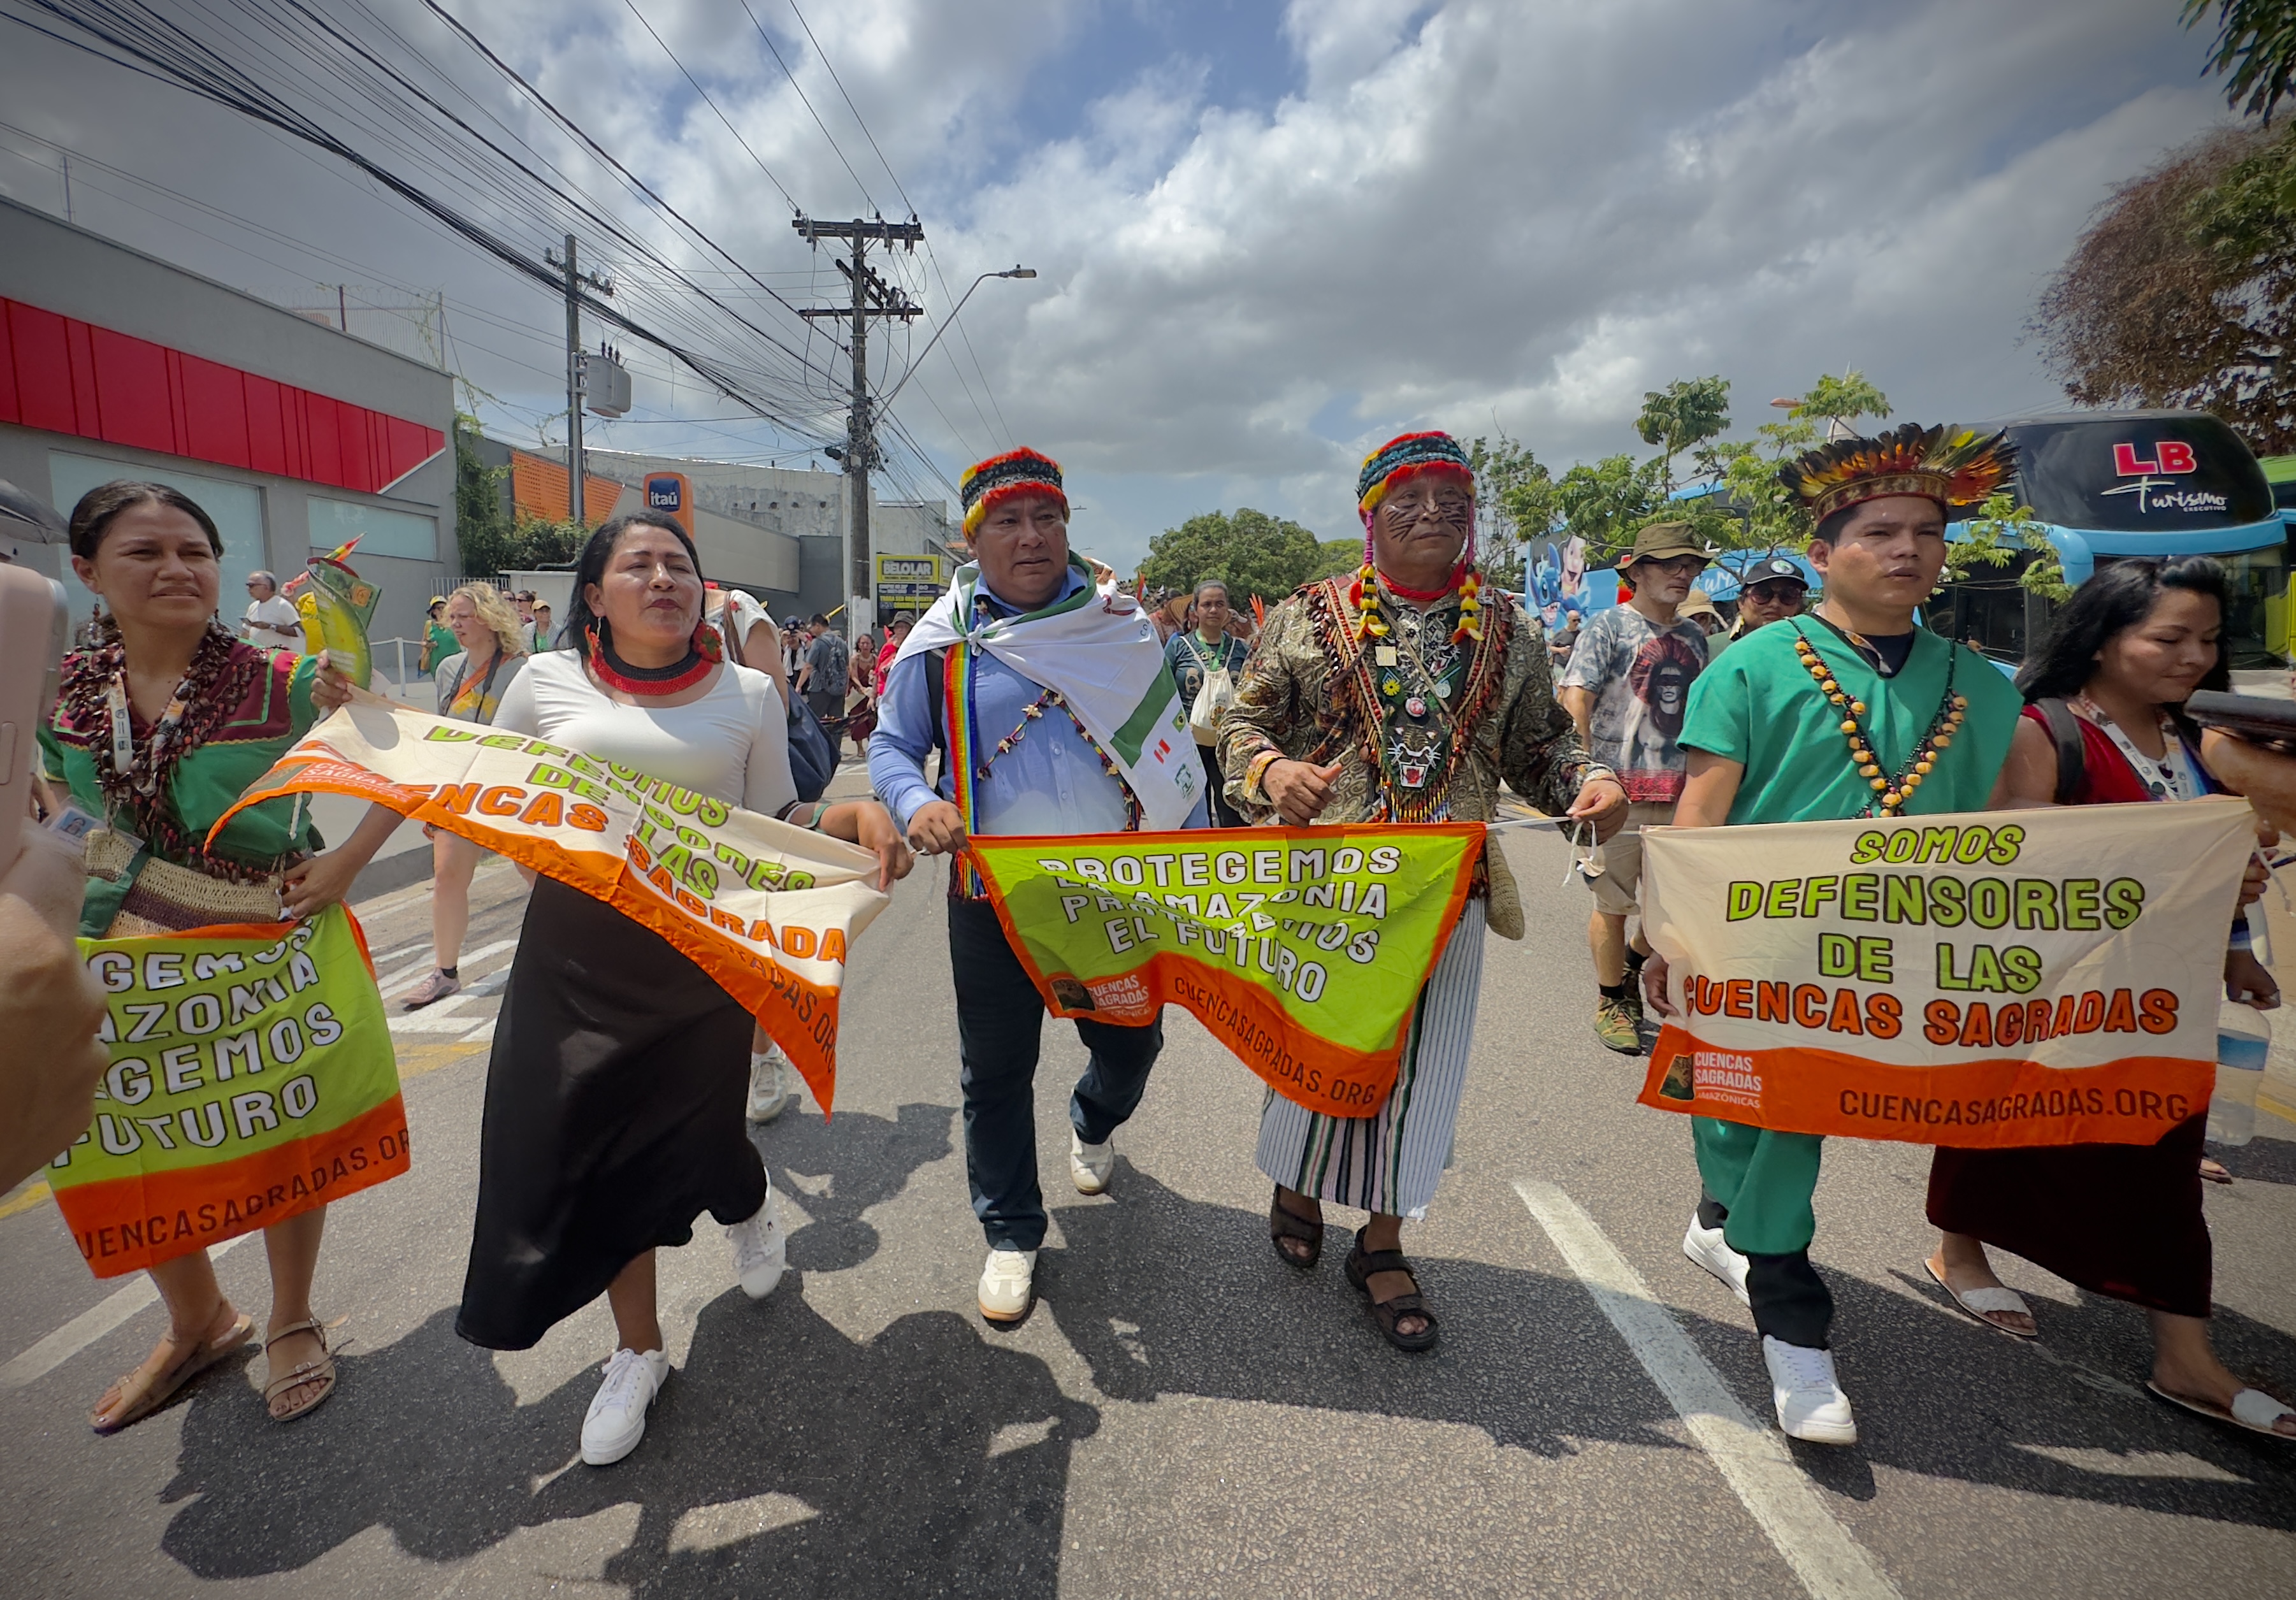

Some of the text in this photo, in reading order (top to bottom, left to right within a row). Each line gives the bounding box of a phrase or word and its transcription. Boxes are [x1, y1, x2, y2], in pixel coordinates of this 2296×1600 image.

[2113, 442, 2197, 477] LB
[650, 491, 678, 506] itaú
[2100, 476, 2228, 514] Turismo
[525, 762, 611, 807] DE
[636, 819, 719, 900] LAS
[1849, 824, 2026, 865] SOMOS
[1037, 846, 1402, 887] PROTEGEMOS
[1726, 873, 2145, 931] DEFENSORES
[1103, 916, 1327, 1003] EL FUTURO
[1818, 932, 2042, 994] DE LAS
[1923, 988, 2179, 1048] SAGRADAS
[94, 1002, 343, 1106] GEMOS
[1174, 977, 1376, 1106] CUENCASAGRADAS.ORG
[1694, 1051, 1753, 1072] CUENCAS
[1694, 1069, 1763, 1092] SAGRADAS
[1839, 1087, 2189, 1125] CUENCASAGRADAS.ORG
